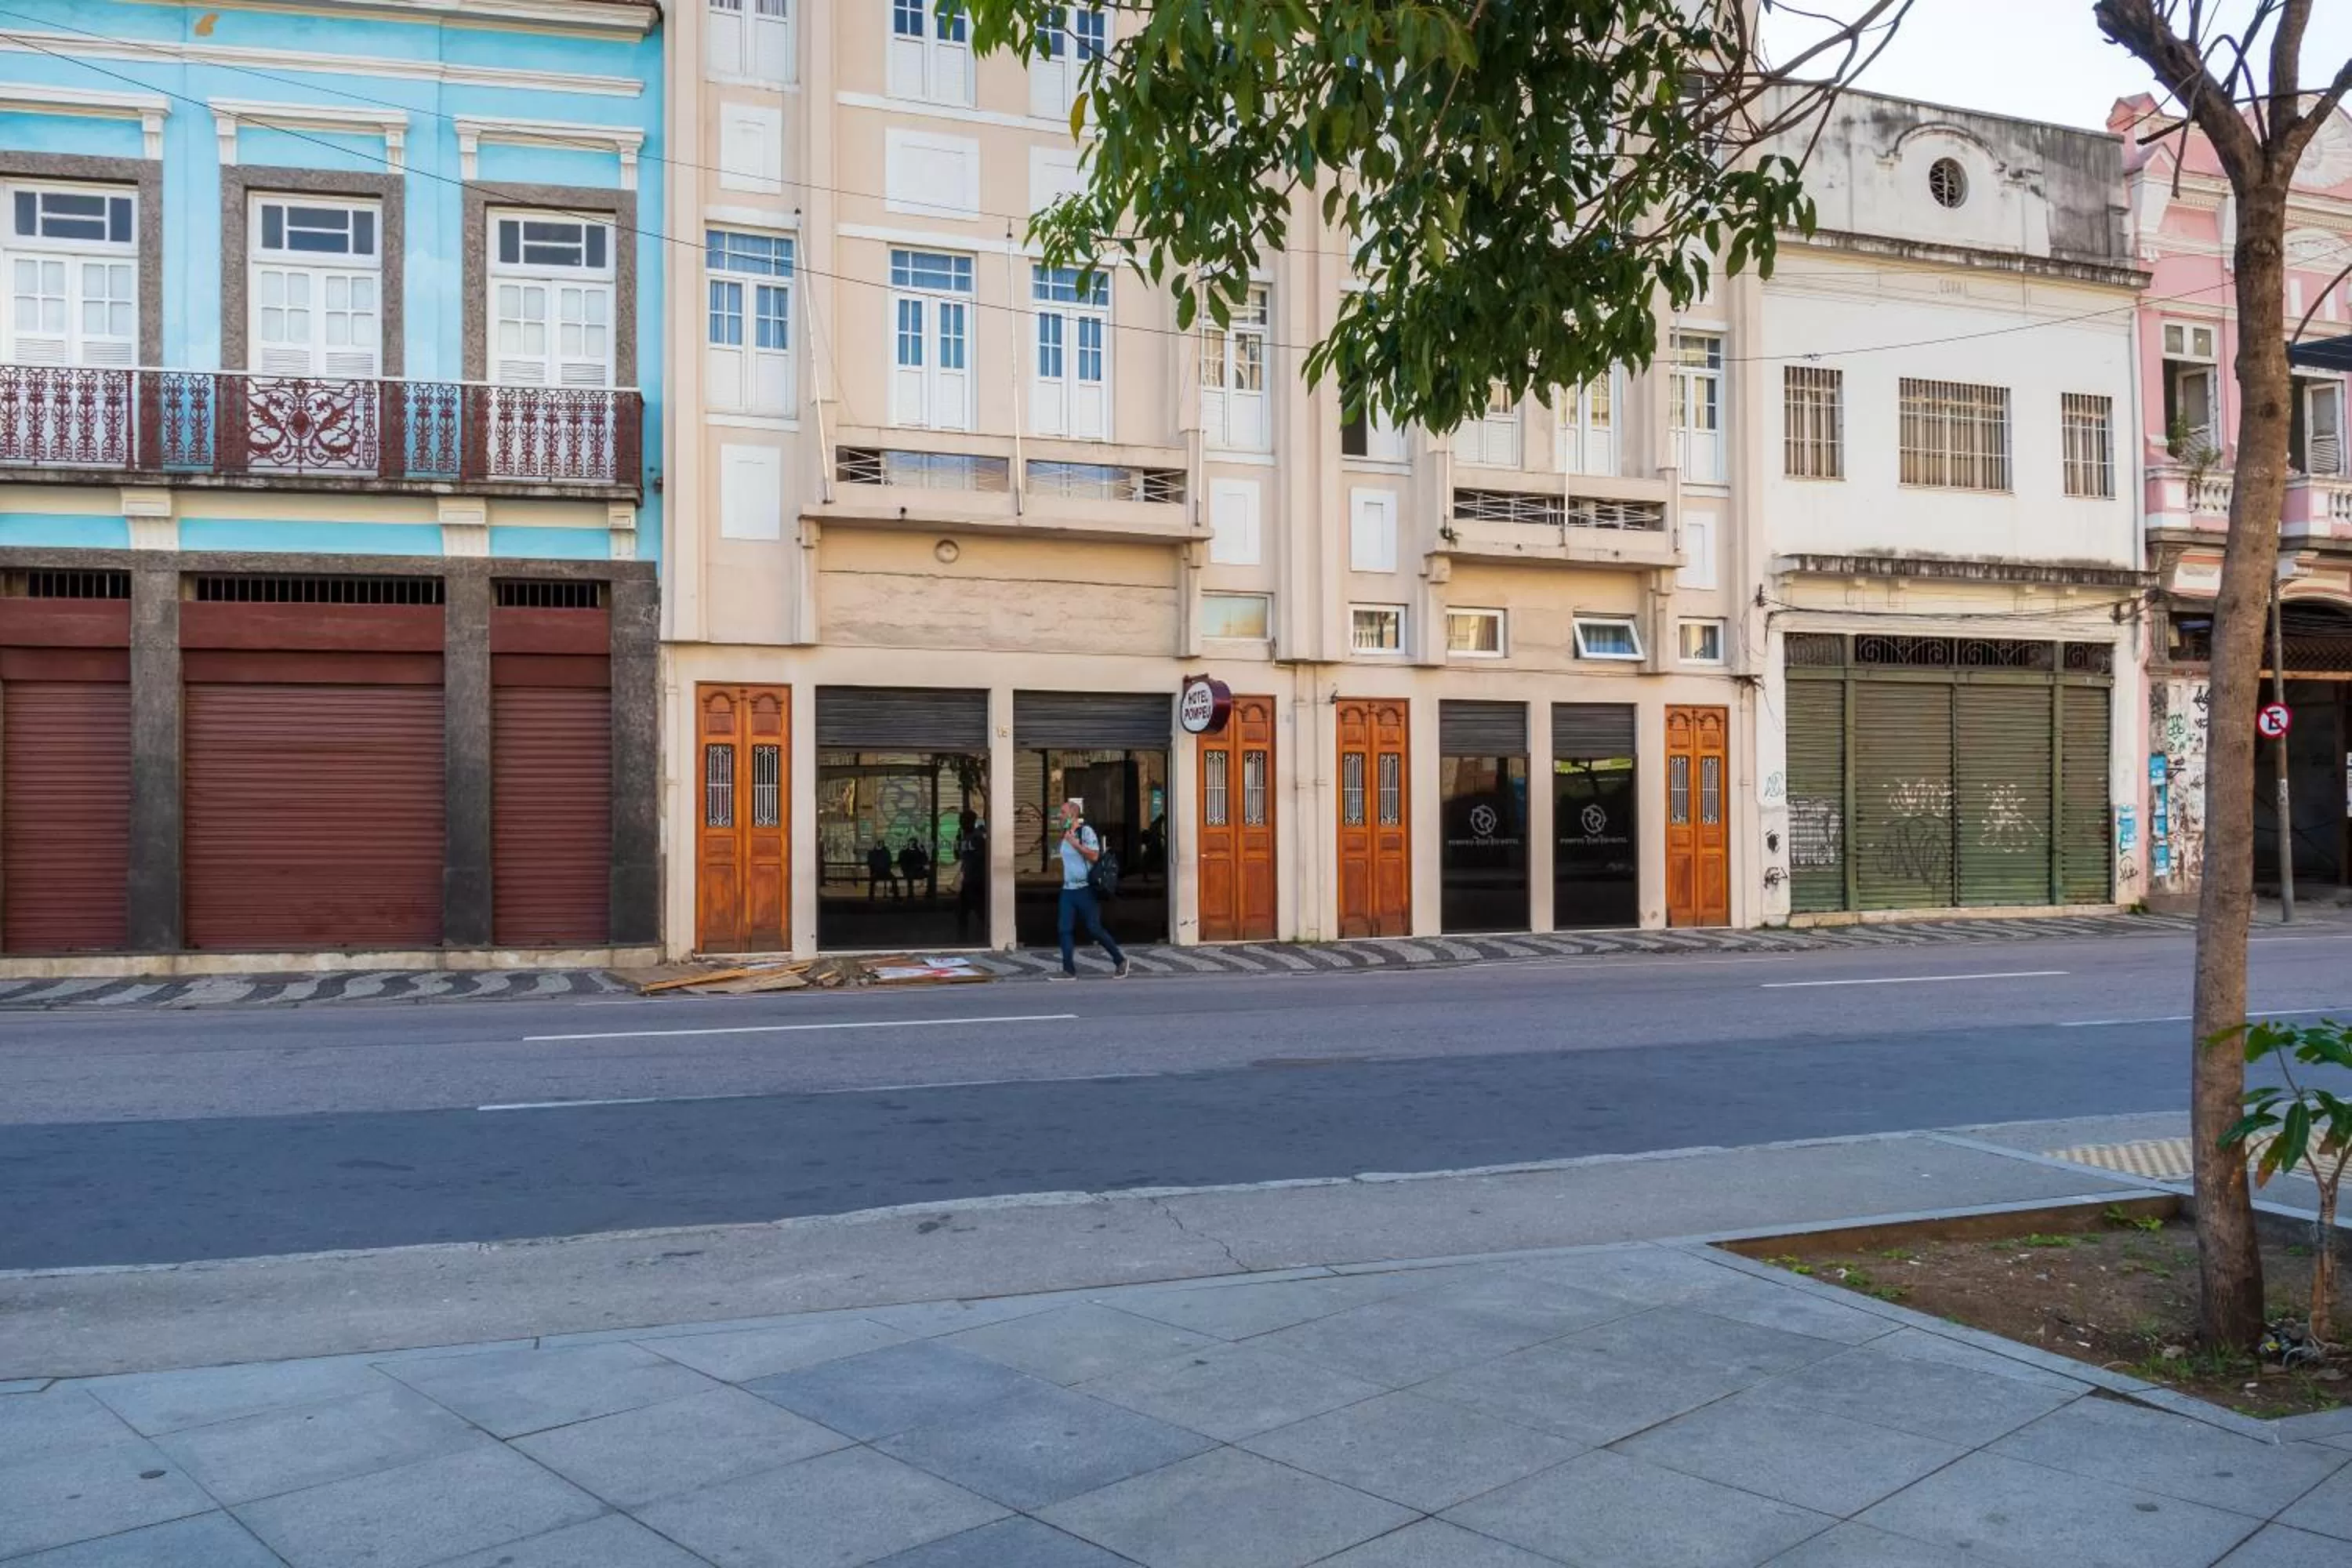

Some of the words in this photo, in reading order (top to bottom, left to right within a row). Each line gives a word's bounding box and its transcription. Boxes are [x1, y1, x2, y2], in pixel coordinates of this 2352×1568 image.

[1188, 690, 1208, 705] HOTEL
[1184, 705, 1211, 721] POMPEU
[2268, 710, 2281, 731] E
